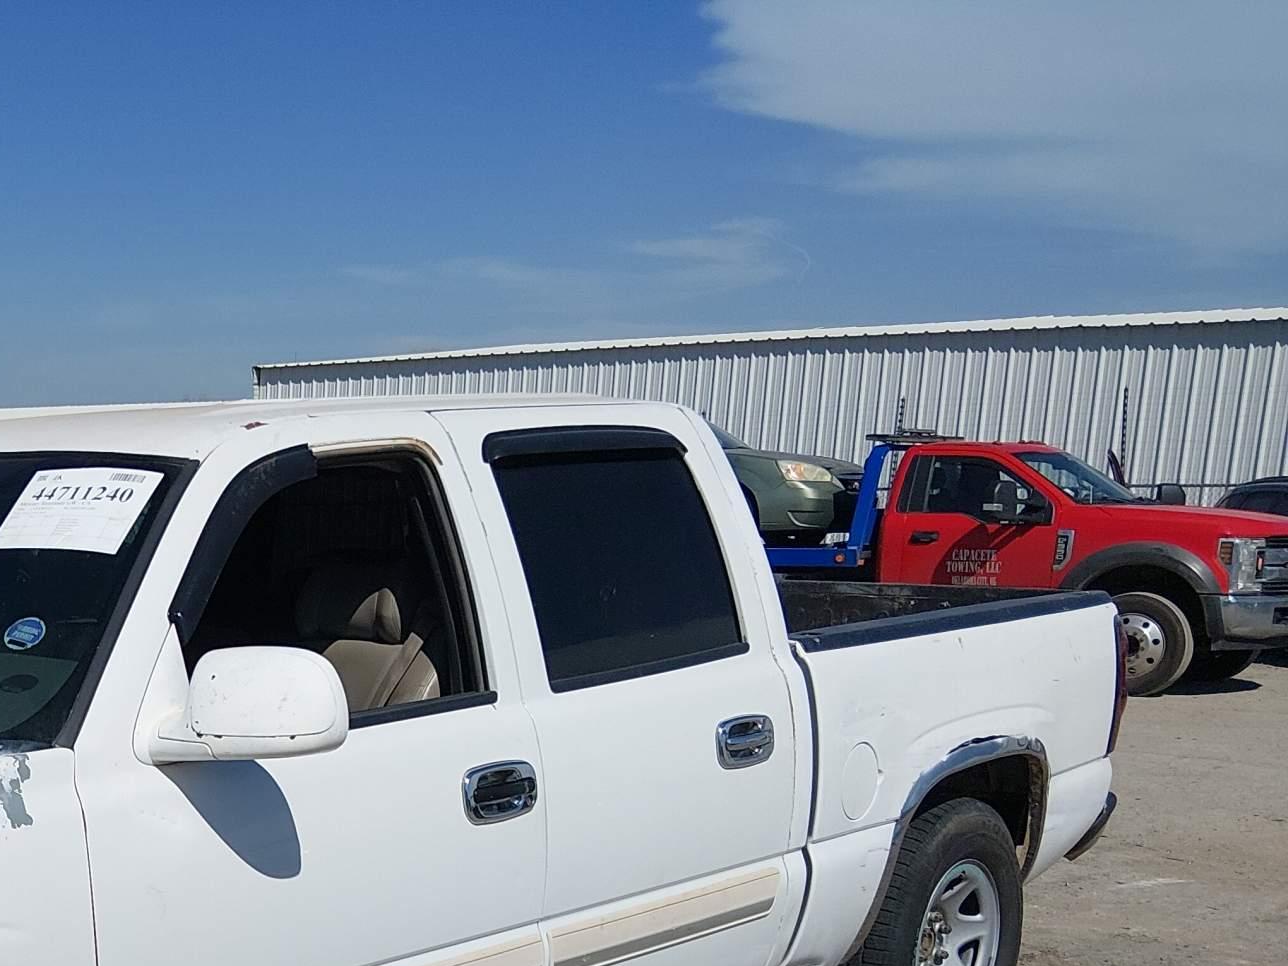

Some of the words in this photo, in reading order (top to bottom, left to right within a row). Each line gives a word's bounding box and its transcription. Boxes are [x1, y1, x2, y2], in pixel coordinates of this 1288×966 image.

[32, 486, 134, 502] 44711240
[952, 549, 998, 561] CAPACETE
[945, 560, 984, 575] TOWING,
[986, 561, 1002, 573] LLC
